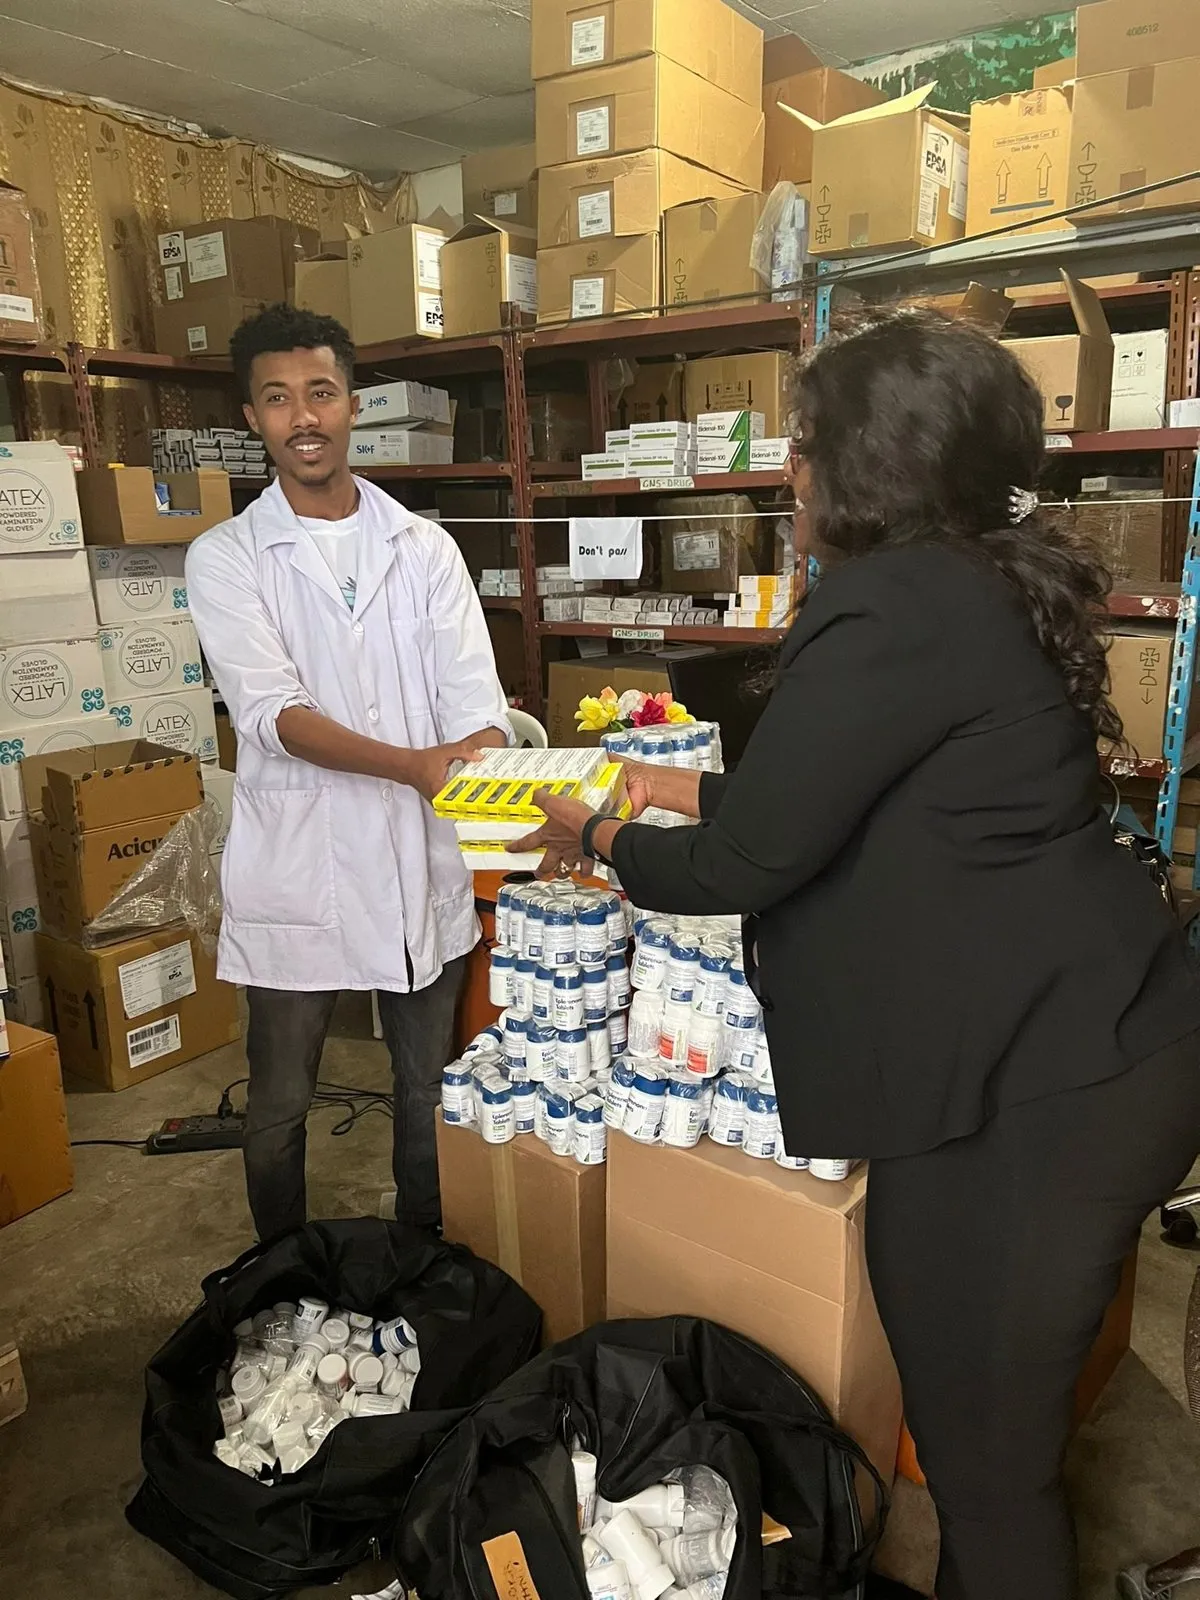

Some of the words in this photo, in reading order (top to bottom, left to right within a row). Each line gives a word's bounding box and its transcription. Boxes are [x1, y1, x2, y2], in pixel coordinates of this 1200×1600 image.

[926, 150, 947, 176] EPSA
[163, 247, 181, 258] EPSA
[578, 545, 603, 556] Don't
[123, 580, 162, 596] LATEX
[13, 664, 58, 675] EXAMINATION
[21, 660, 47, 668] GLOVES
[126, 657, 171, 675] LATEX
[19, 672, 54, 681] POWDERED
[11, 682, 66, 703] LATEX
[146, 714, 191, 734] LATEX
